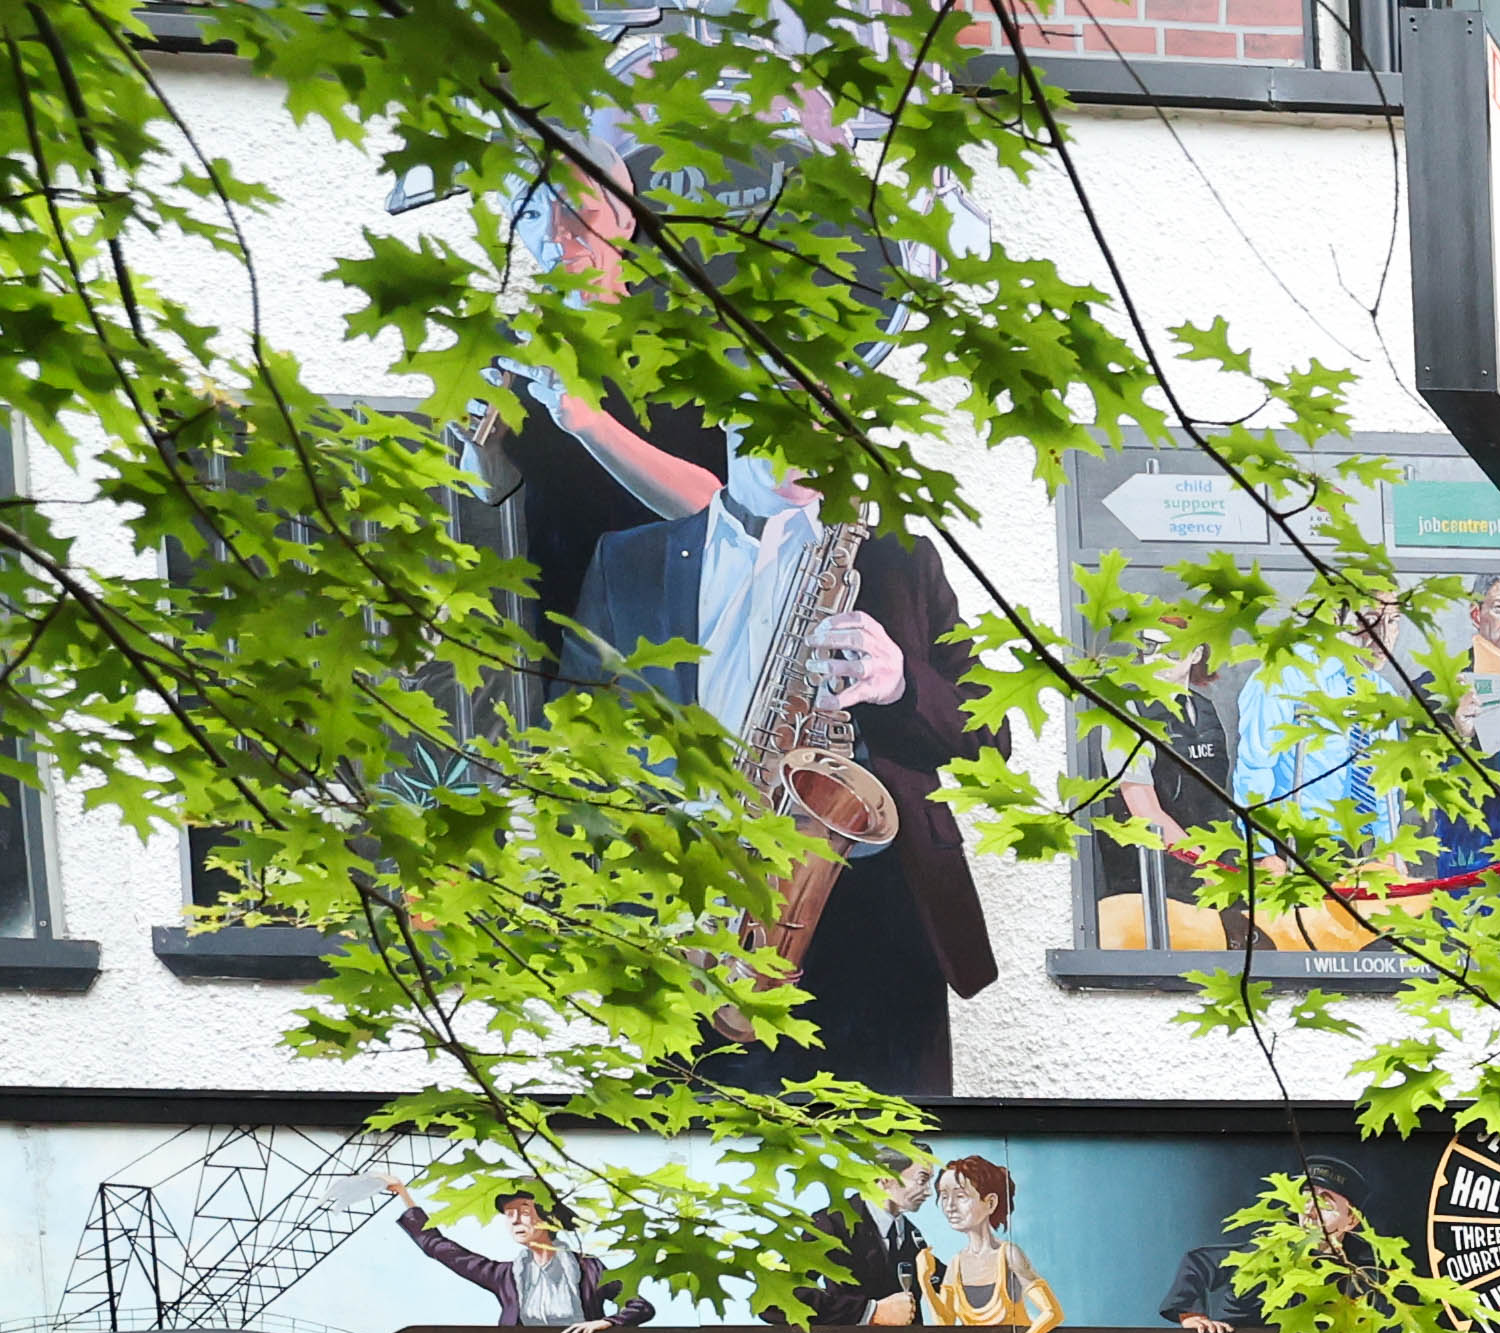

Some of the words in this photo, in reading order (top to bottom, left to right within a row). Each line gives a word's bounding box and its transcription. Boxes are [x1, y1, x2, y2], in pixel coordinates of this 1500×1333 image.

[1175, 478, 1213, 494] child
[1163, 496, 1225, 511] support
[1169, 520, 1223, 537] agency
[1314, 958, 1349, 973] WILL
[1353, 957, 1397, 973] LOOK
